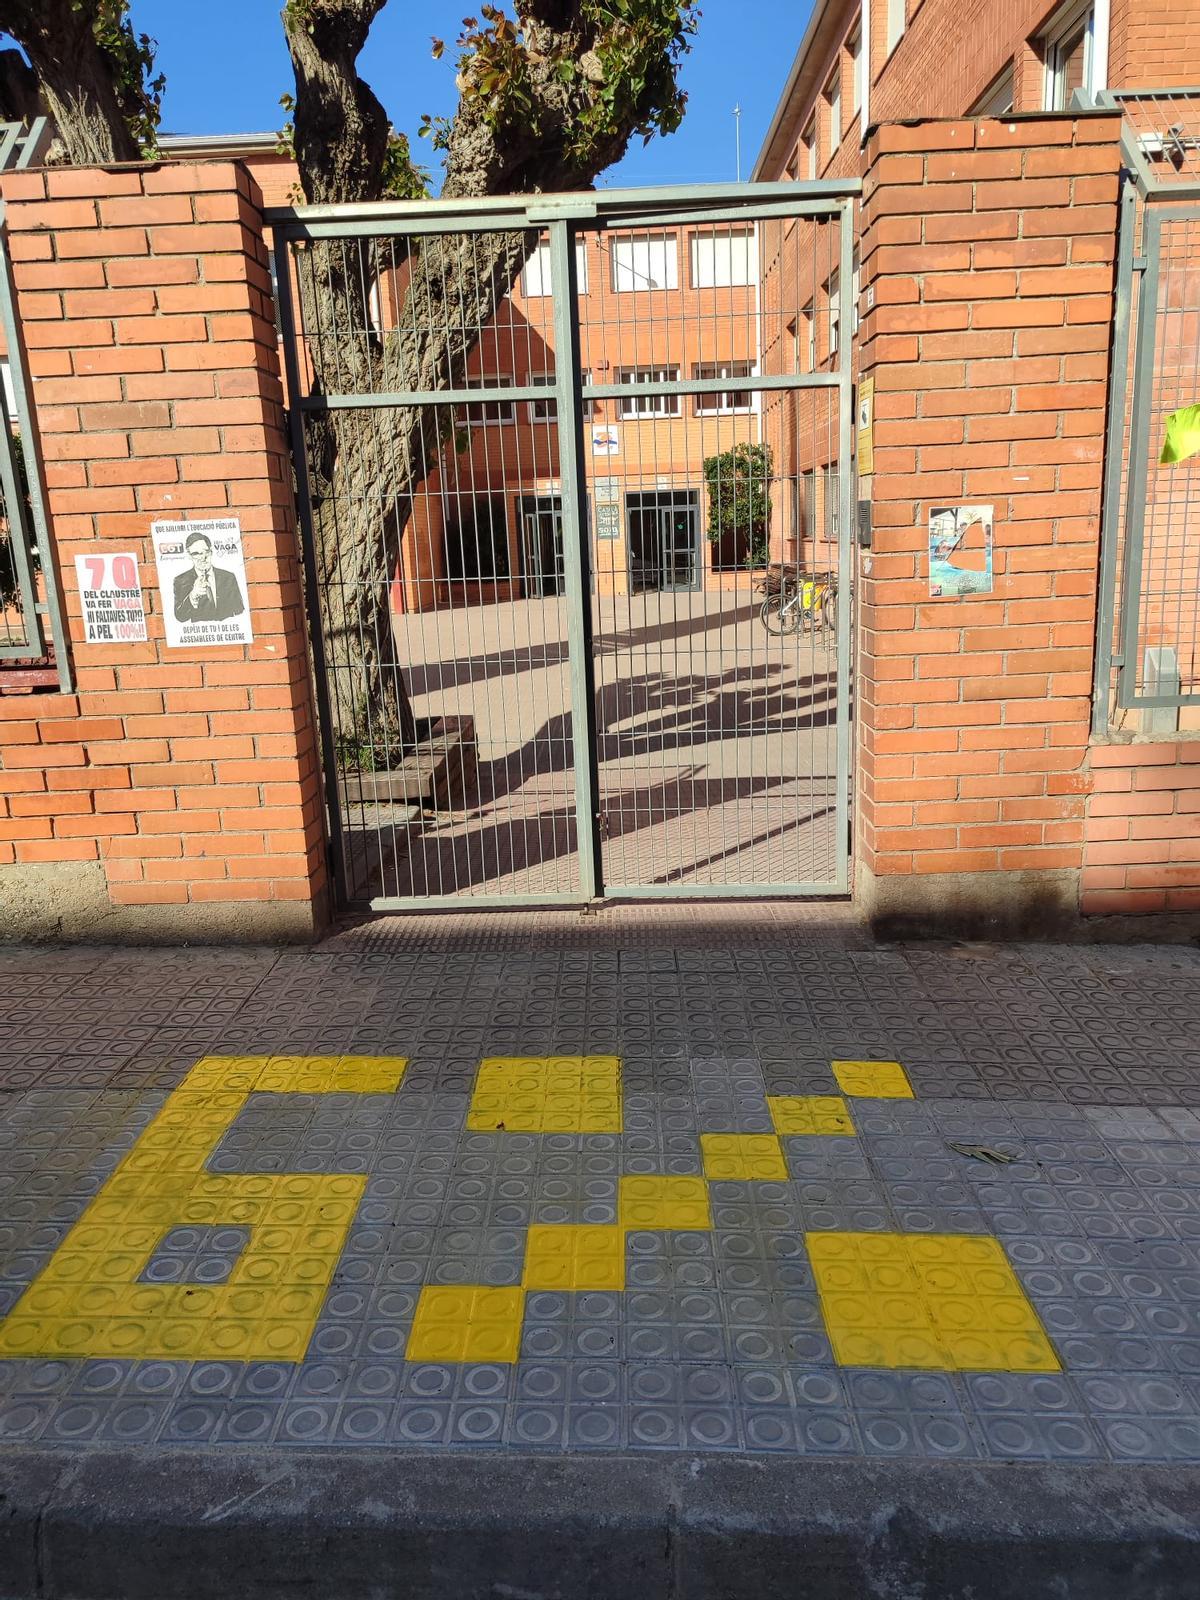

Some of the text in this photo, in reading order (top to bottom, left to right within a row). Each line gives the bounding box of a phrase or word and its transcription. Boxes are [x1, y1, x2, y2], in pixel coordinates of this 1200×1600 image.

[160, 543, 183, 553] CGT
[213, 543, 238, 551] VAGA
[84, 589, 141, 599] DEL CLAUSTRE
[85, 599, 141, 609] VA FER VAGA
[87, 610, 95, 624] HI
[96, 609, 126, 623] FALTAVES
[89, 624, 96, 640] A
[97, 624, 113, 640] PEL
[201, 625, 209, 633] DE
[209, 624, 217, 633] TU
[221, 624, 229, 632] DE
[229, 624, 240, 632] LES
[179, 633, 245, 643] ASSEMBLEES DE CENTRE
